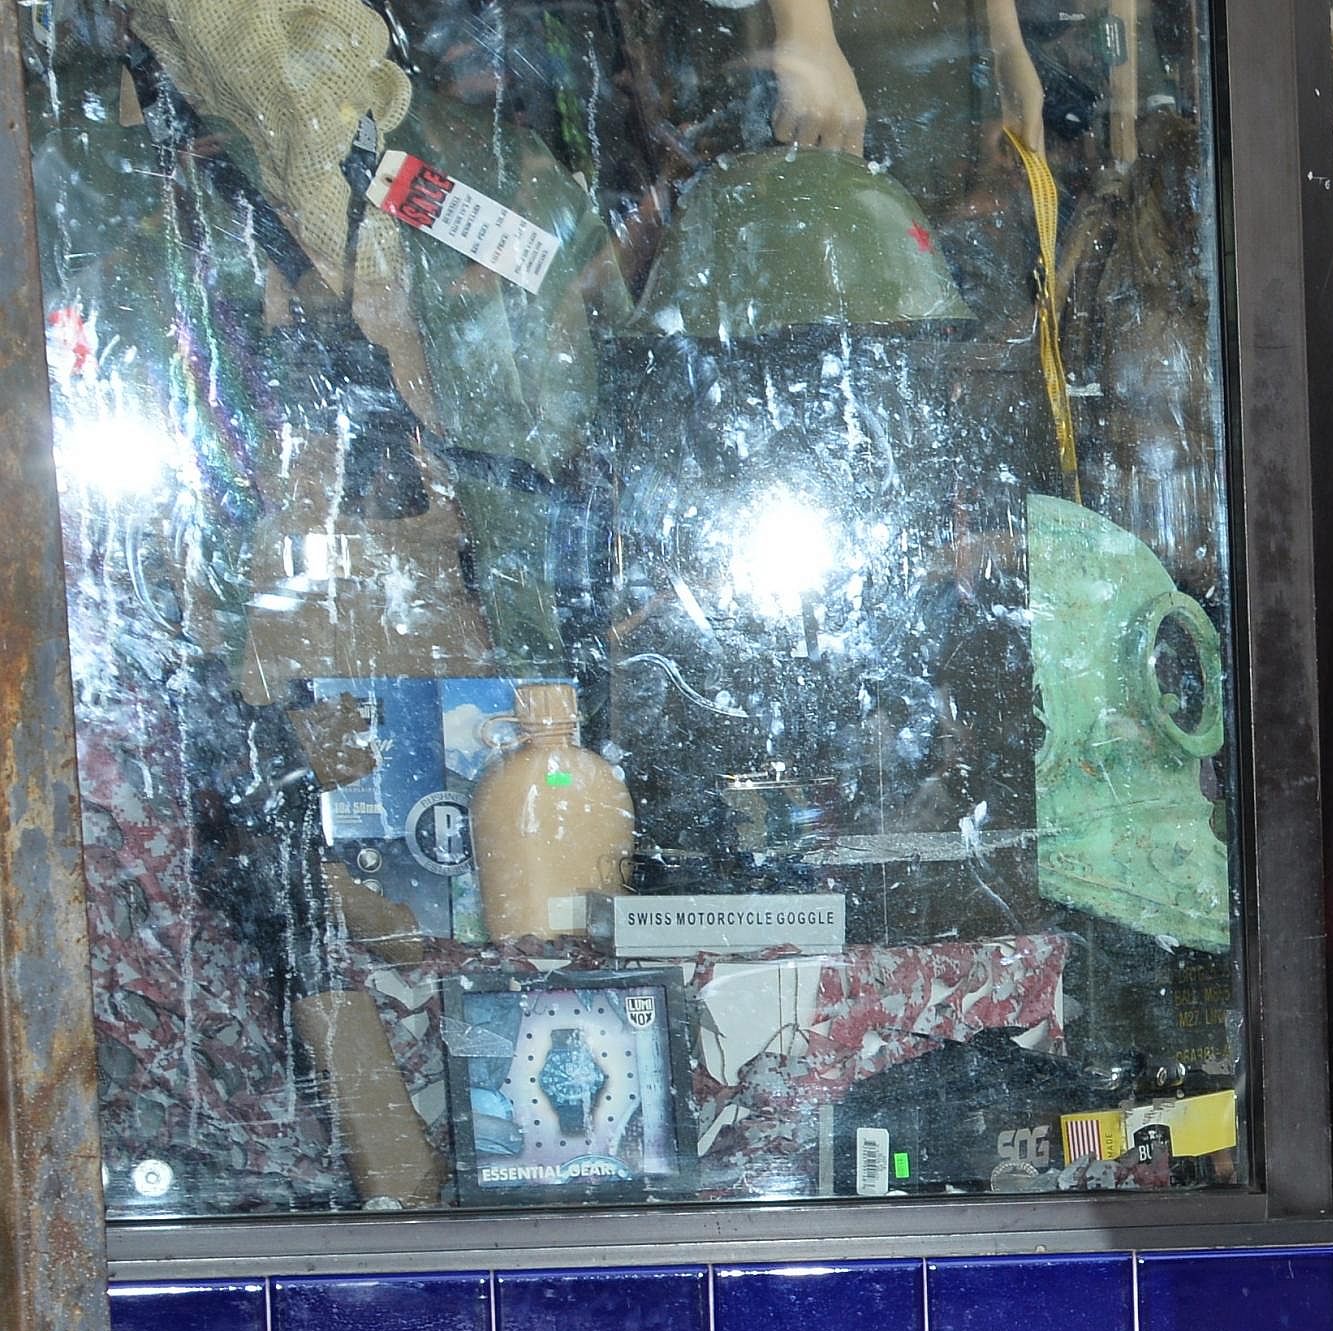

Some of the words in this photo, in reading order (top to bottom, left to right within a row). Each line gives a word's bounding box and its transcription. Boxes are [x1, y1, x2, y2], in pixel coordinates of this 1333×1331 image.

[398, 164, 455, 229] SALE
[628, 912, 672, 925] SWISS
[676, 912, 772, 925] MOTORCYCLE
[777, 911, 834, 925] GOGGLE
[482, 1165, 563, 1182] ESSENTIAL
